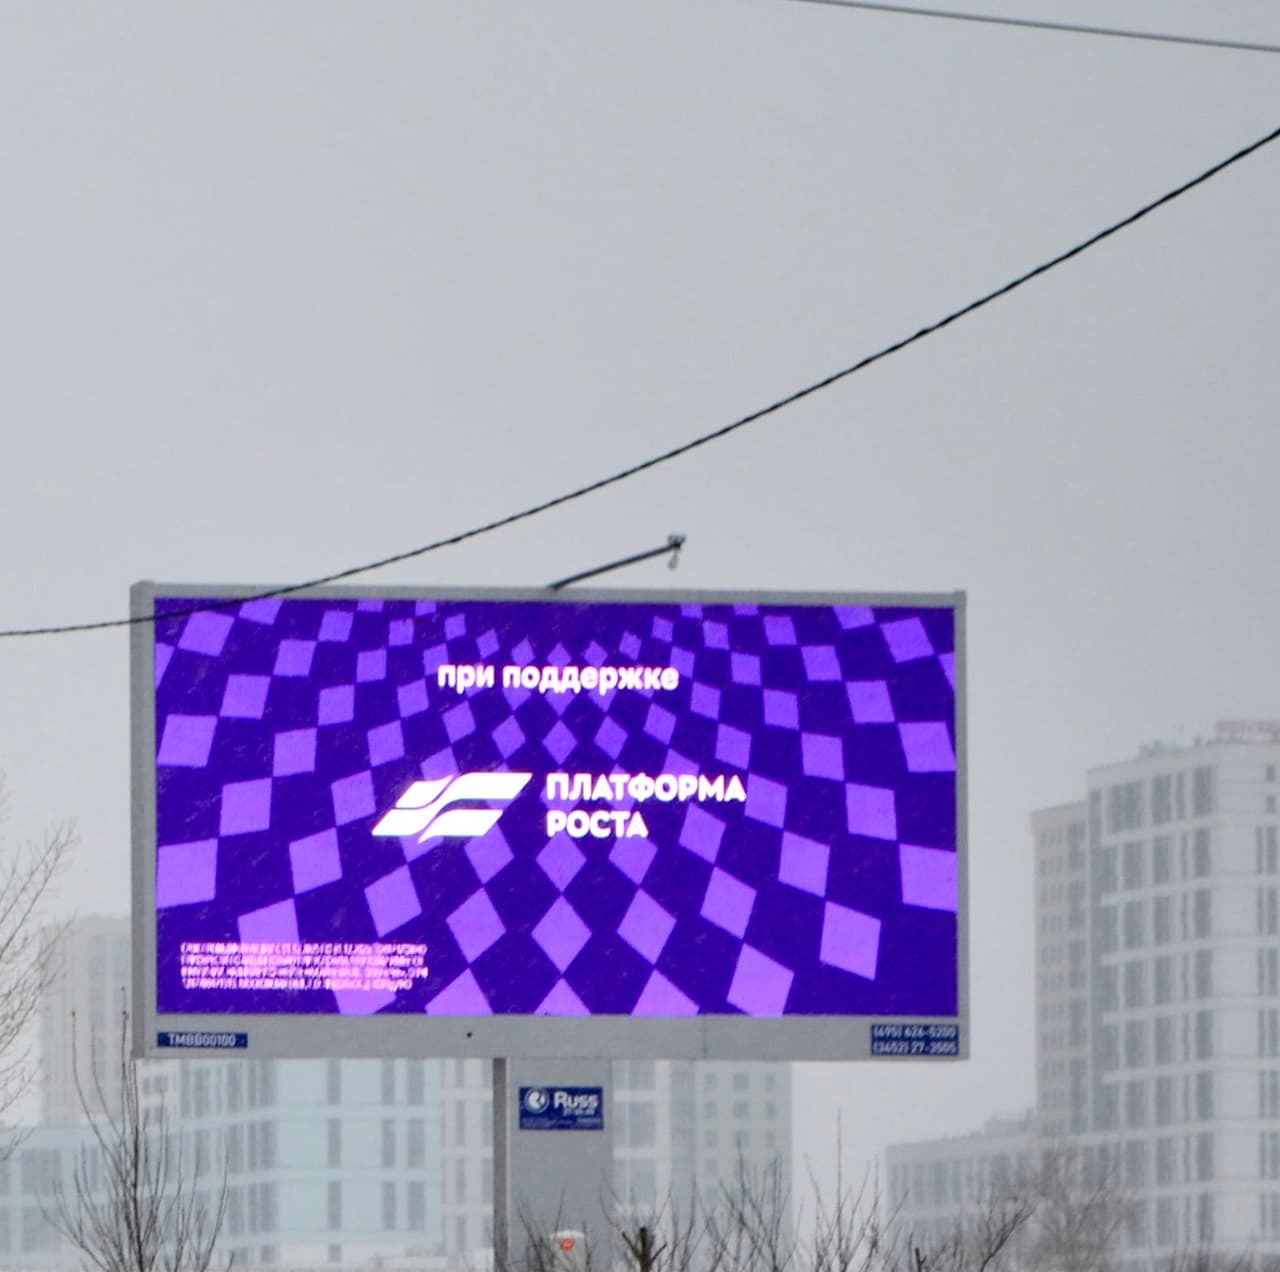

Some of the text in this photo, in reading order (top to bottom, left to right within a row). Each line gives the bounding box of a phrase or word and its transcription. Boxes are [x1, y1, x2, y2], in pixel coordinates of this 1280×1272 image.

[438, 665, 679, 696] при поддержке
[546, 772, 747, 802] ПЛАТФОРМА
[546, 810, 649, 838] РОСТА
[554, 1091, 599, 1109] Russ
